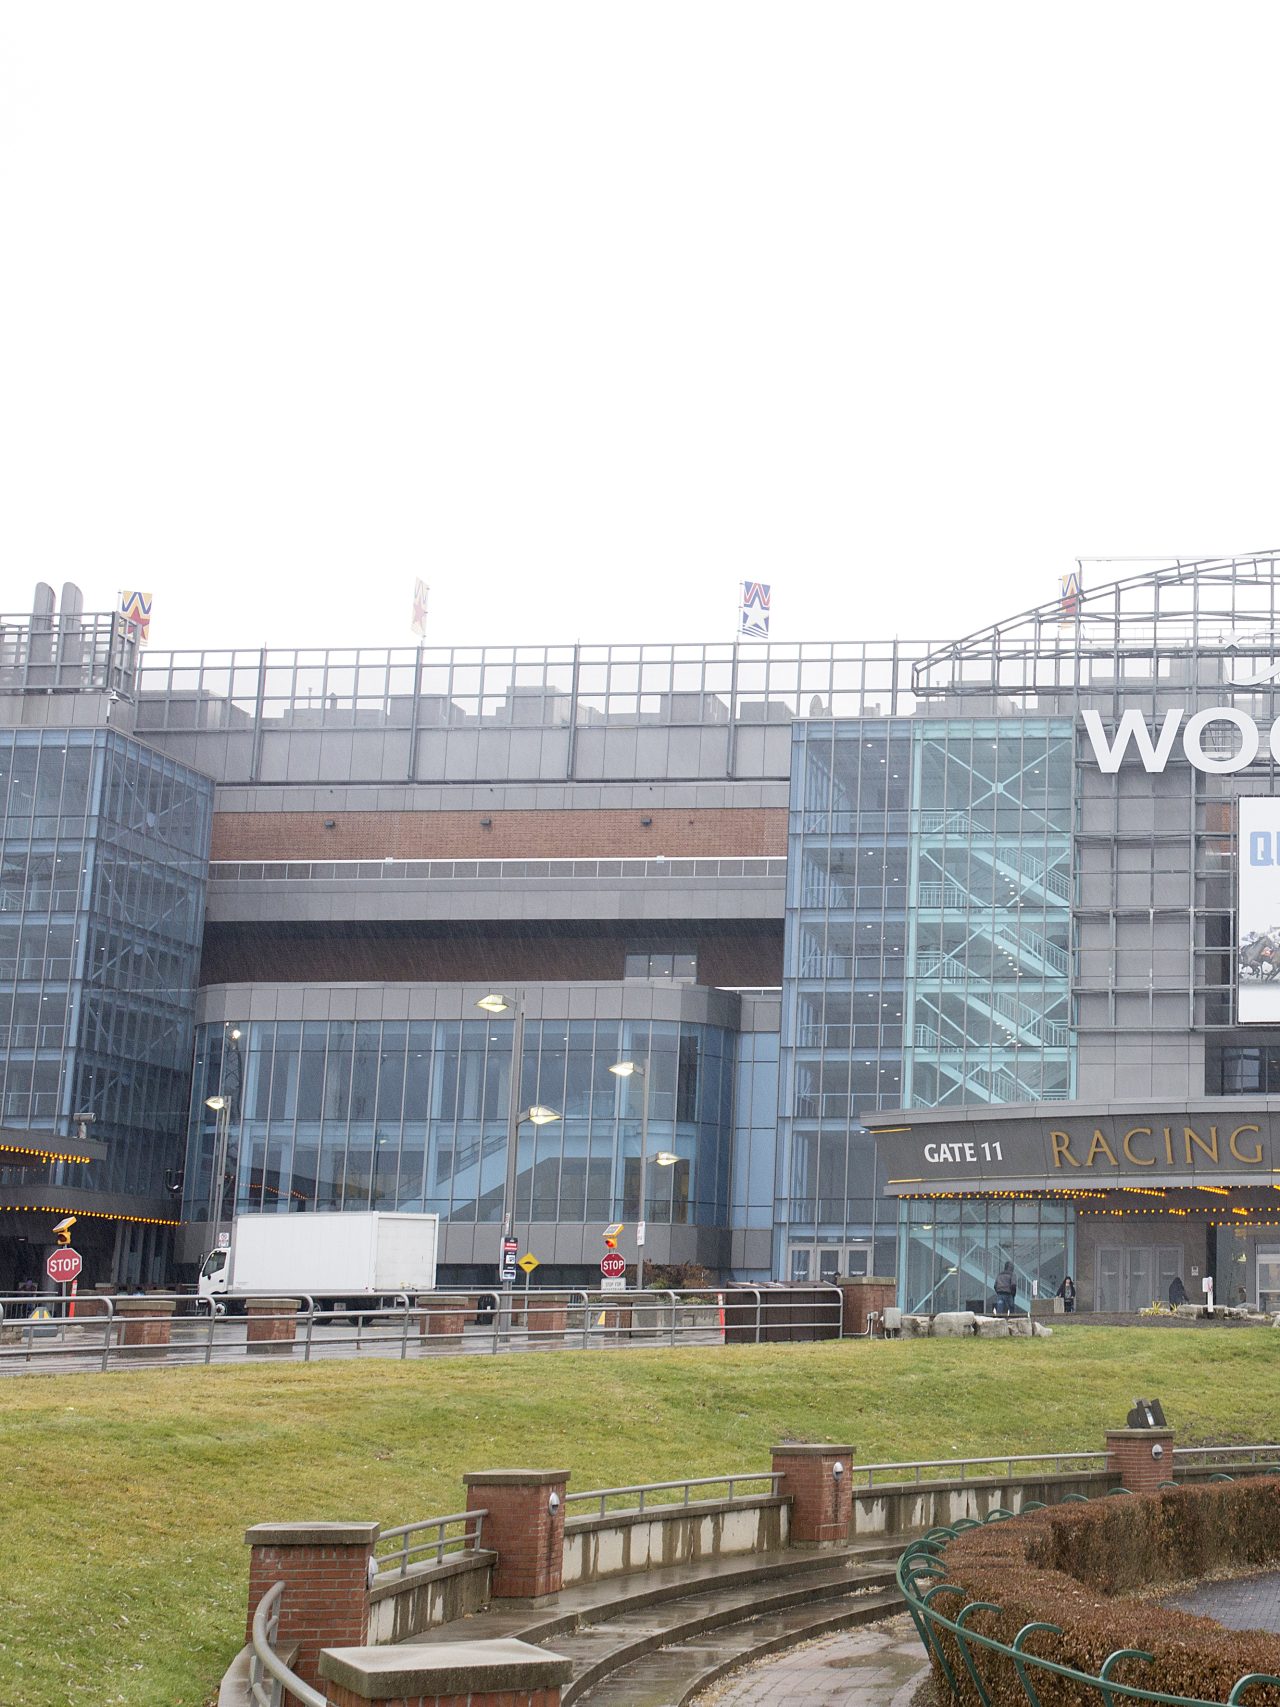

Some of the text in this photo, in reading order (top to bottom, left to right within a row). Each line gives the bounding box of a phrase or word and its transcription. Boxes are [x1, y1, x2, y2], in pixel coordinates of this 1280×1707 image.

[923, 1141, 1004, 1164] GATE 11
[1049, 1124, 1264, 1168] RACING
[50, 1257, 80, 1273] STOP
[603, 1260, 624, 1270] STOP
